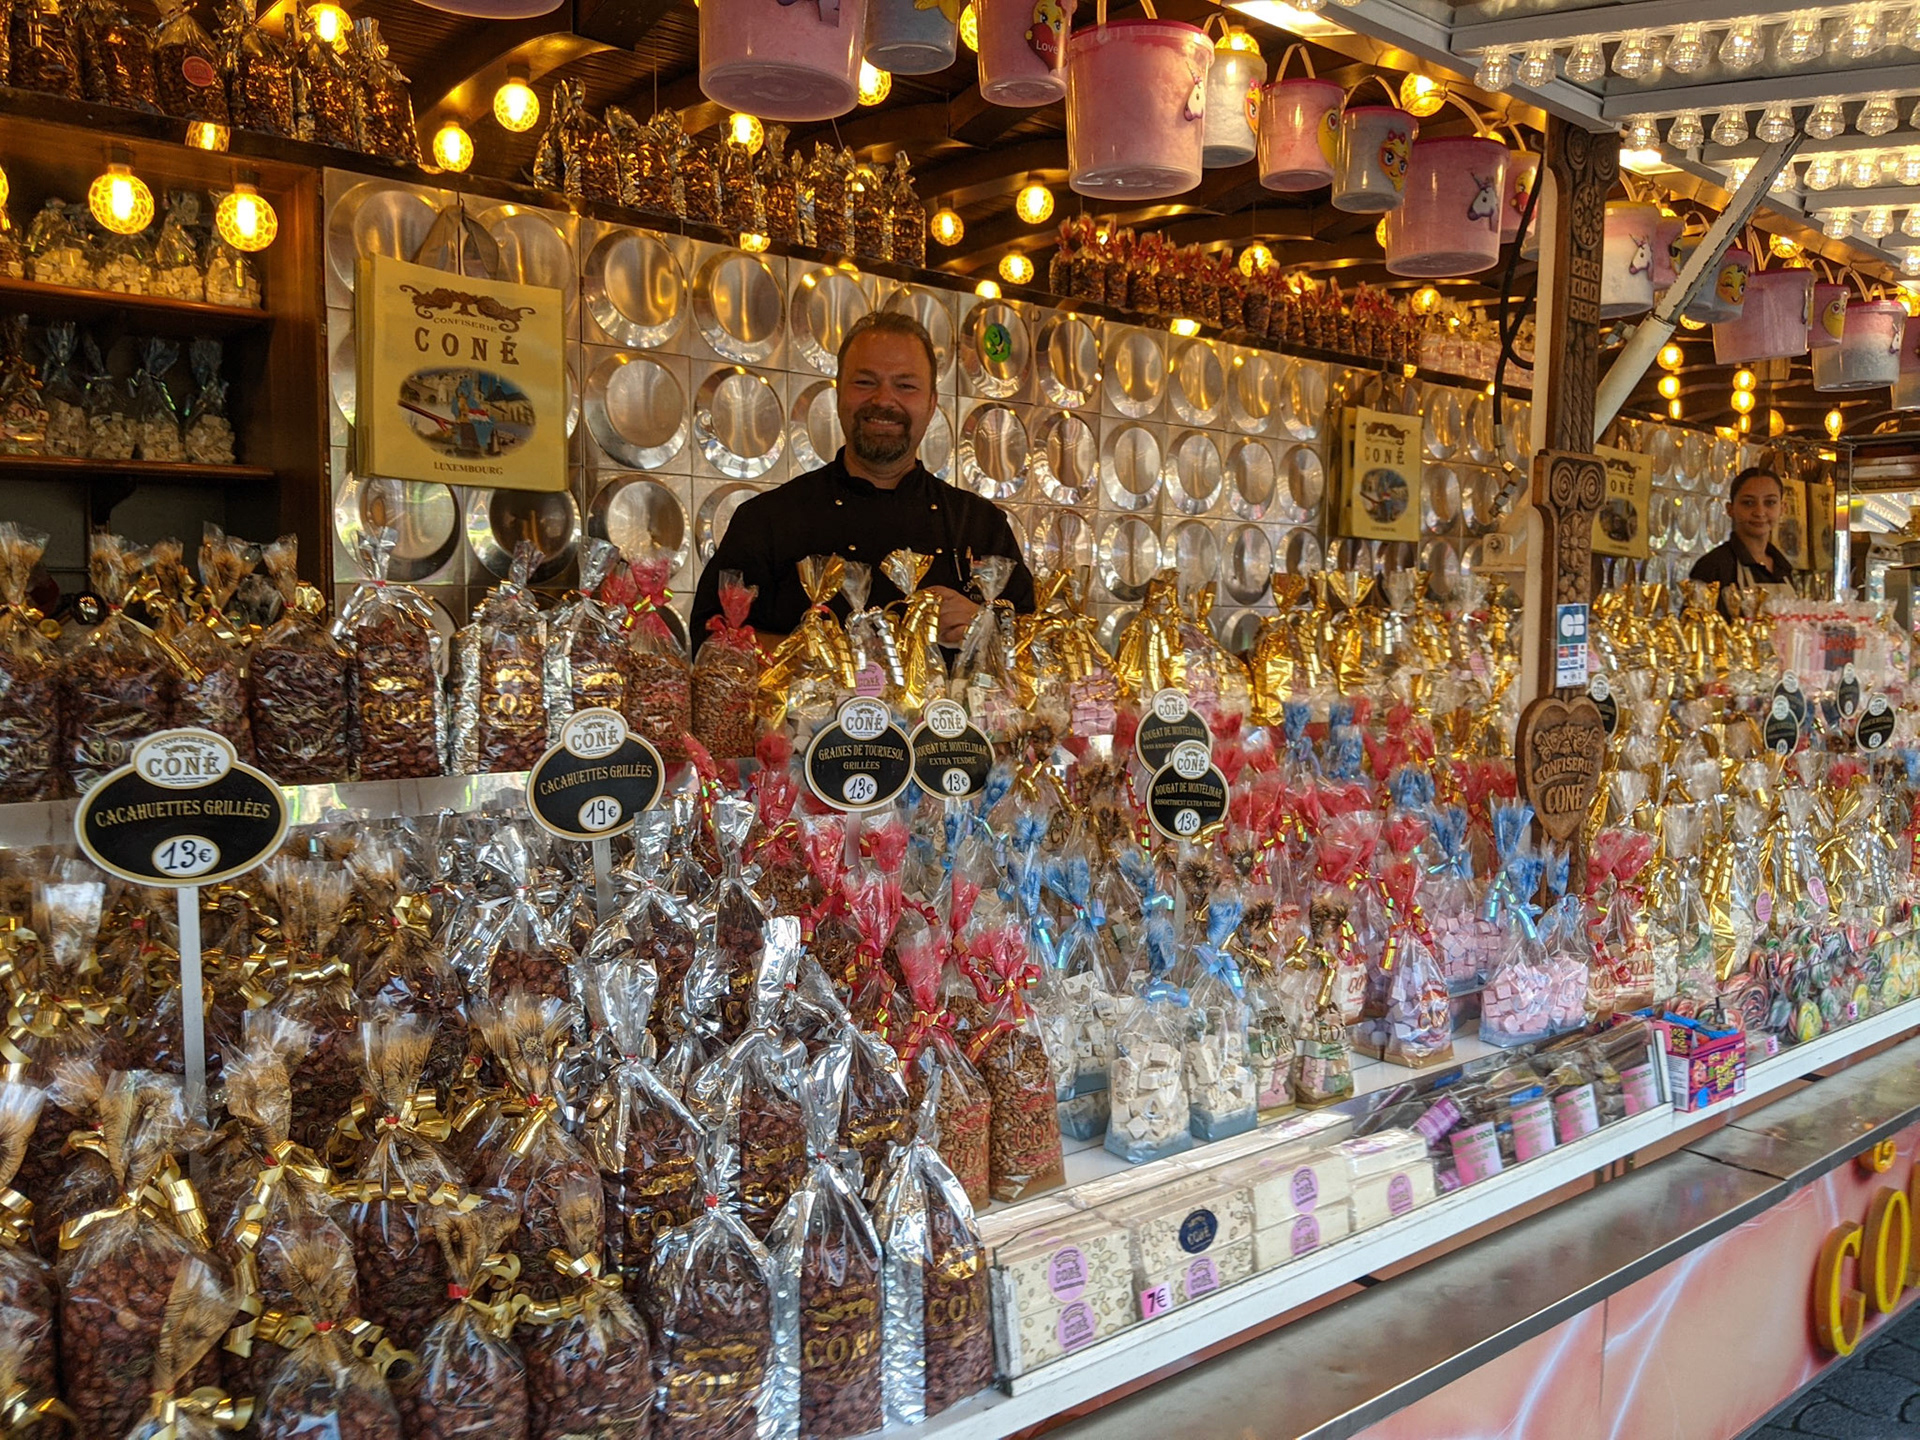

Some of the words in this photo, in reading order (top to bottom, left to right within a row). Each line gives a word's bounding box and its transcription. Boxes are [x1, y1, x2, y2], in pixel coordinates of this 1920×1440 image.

[1036, 40, 1058, 54] Love
[433, 317, 498, 334] CONFISERIE
[414, 326, 520, 366] CONÉ
[1364, 447, 1405, 465] CONÉ
[434, 461, 504, 476] LUXEMBOURG
[1158, 701, 1186, 717] CONÉ
[845, 713, 884, 731] CONÉ
[931, 713, 964, 731] CONÉ
[571, 725, 620, 751] CONÉ
[818, 744, 852, 761] GRAINES
[853, 744, 863, 756] DE
[864, 743, 904, 761] TOURNESOL
[940, 742, 949, 754] DE
[145, 751, 222, 778] CONÉ
[843, 758, 881, 770] GRILLÉES
[929, 757, 951, 766] EXTRA
[1177, 756, 1206, 773] CONÉ
[1534, 756, 1594, 783] CONFISERIE
[540, 765, 609, 796] CACAHUETTES
[609, 761, 653, 779] GRILLÉES
[948, 773, 968, 792] 13€
[848, 777, 874, 800] 13€
[1545, 774, 1585, 814] CONÉ
[94, 799, 201, 828] CACAHUETTES
[203, 797, 272, 819] GRILLÉES
[586, 799, 617, 825] 19€
[1177, 811, 1198, 831] 13€
[160, 839, 213, 870] 13€
[1147, 1288, 1168, 1313] 7€
